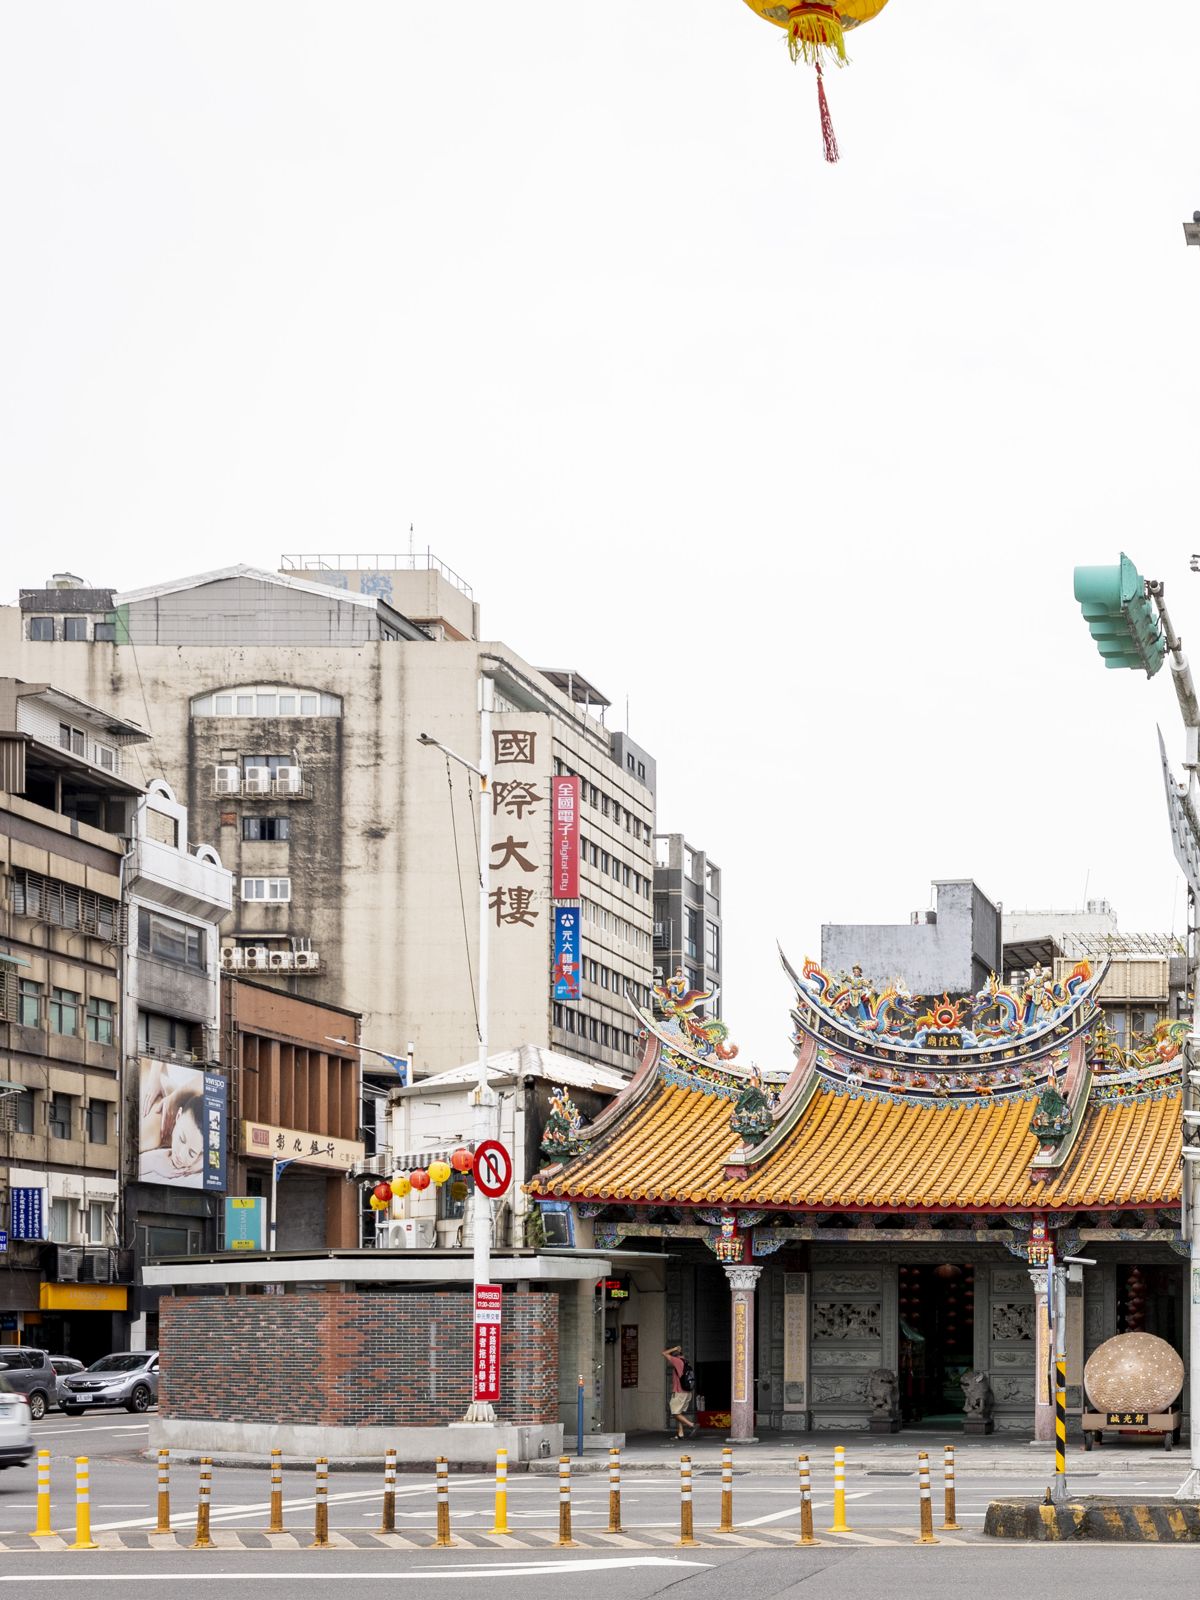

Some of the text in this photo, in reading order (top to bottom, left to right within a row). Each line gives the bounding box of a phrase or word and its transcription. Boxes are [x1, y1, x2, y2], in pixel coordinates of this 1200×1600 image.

[488, 730, 543, 928] 國際大樓
[276, 1132, 335, 1158] 彰化銀行
